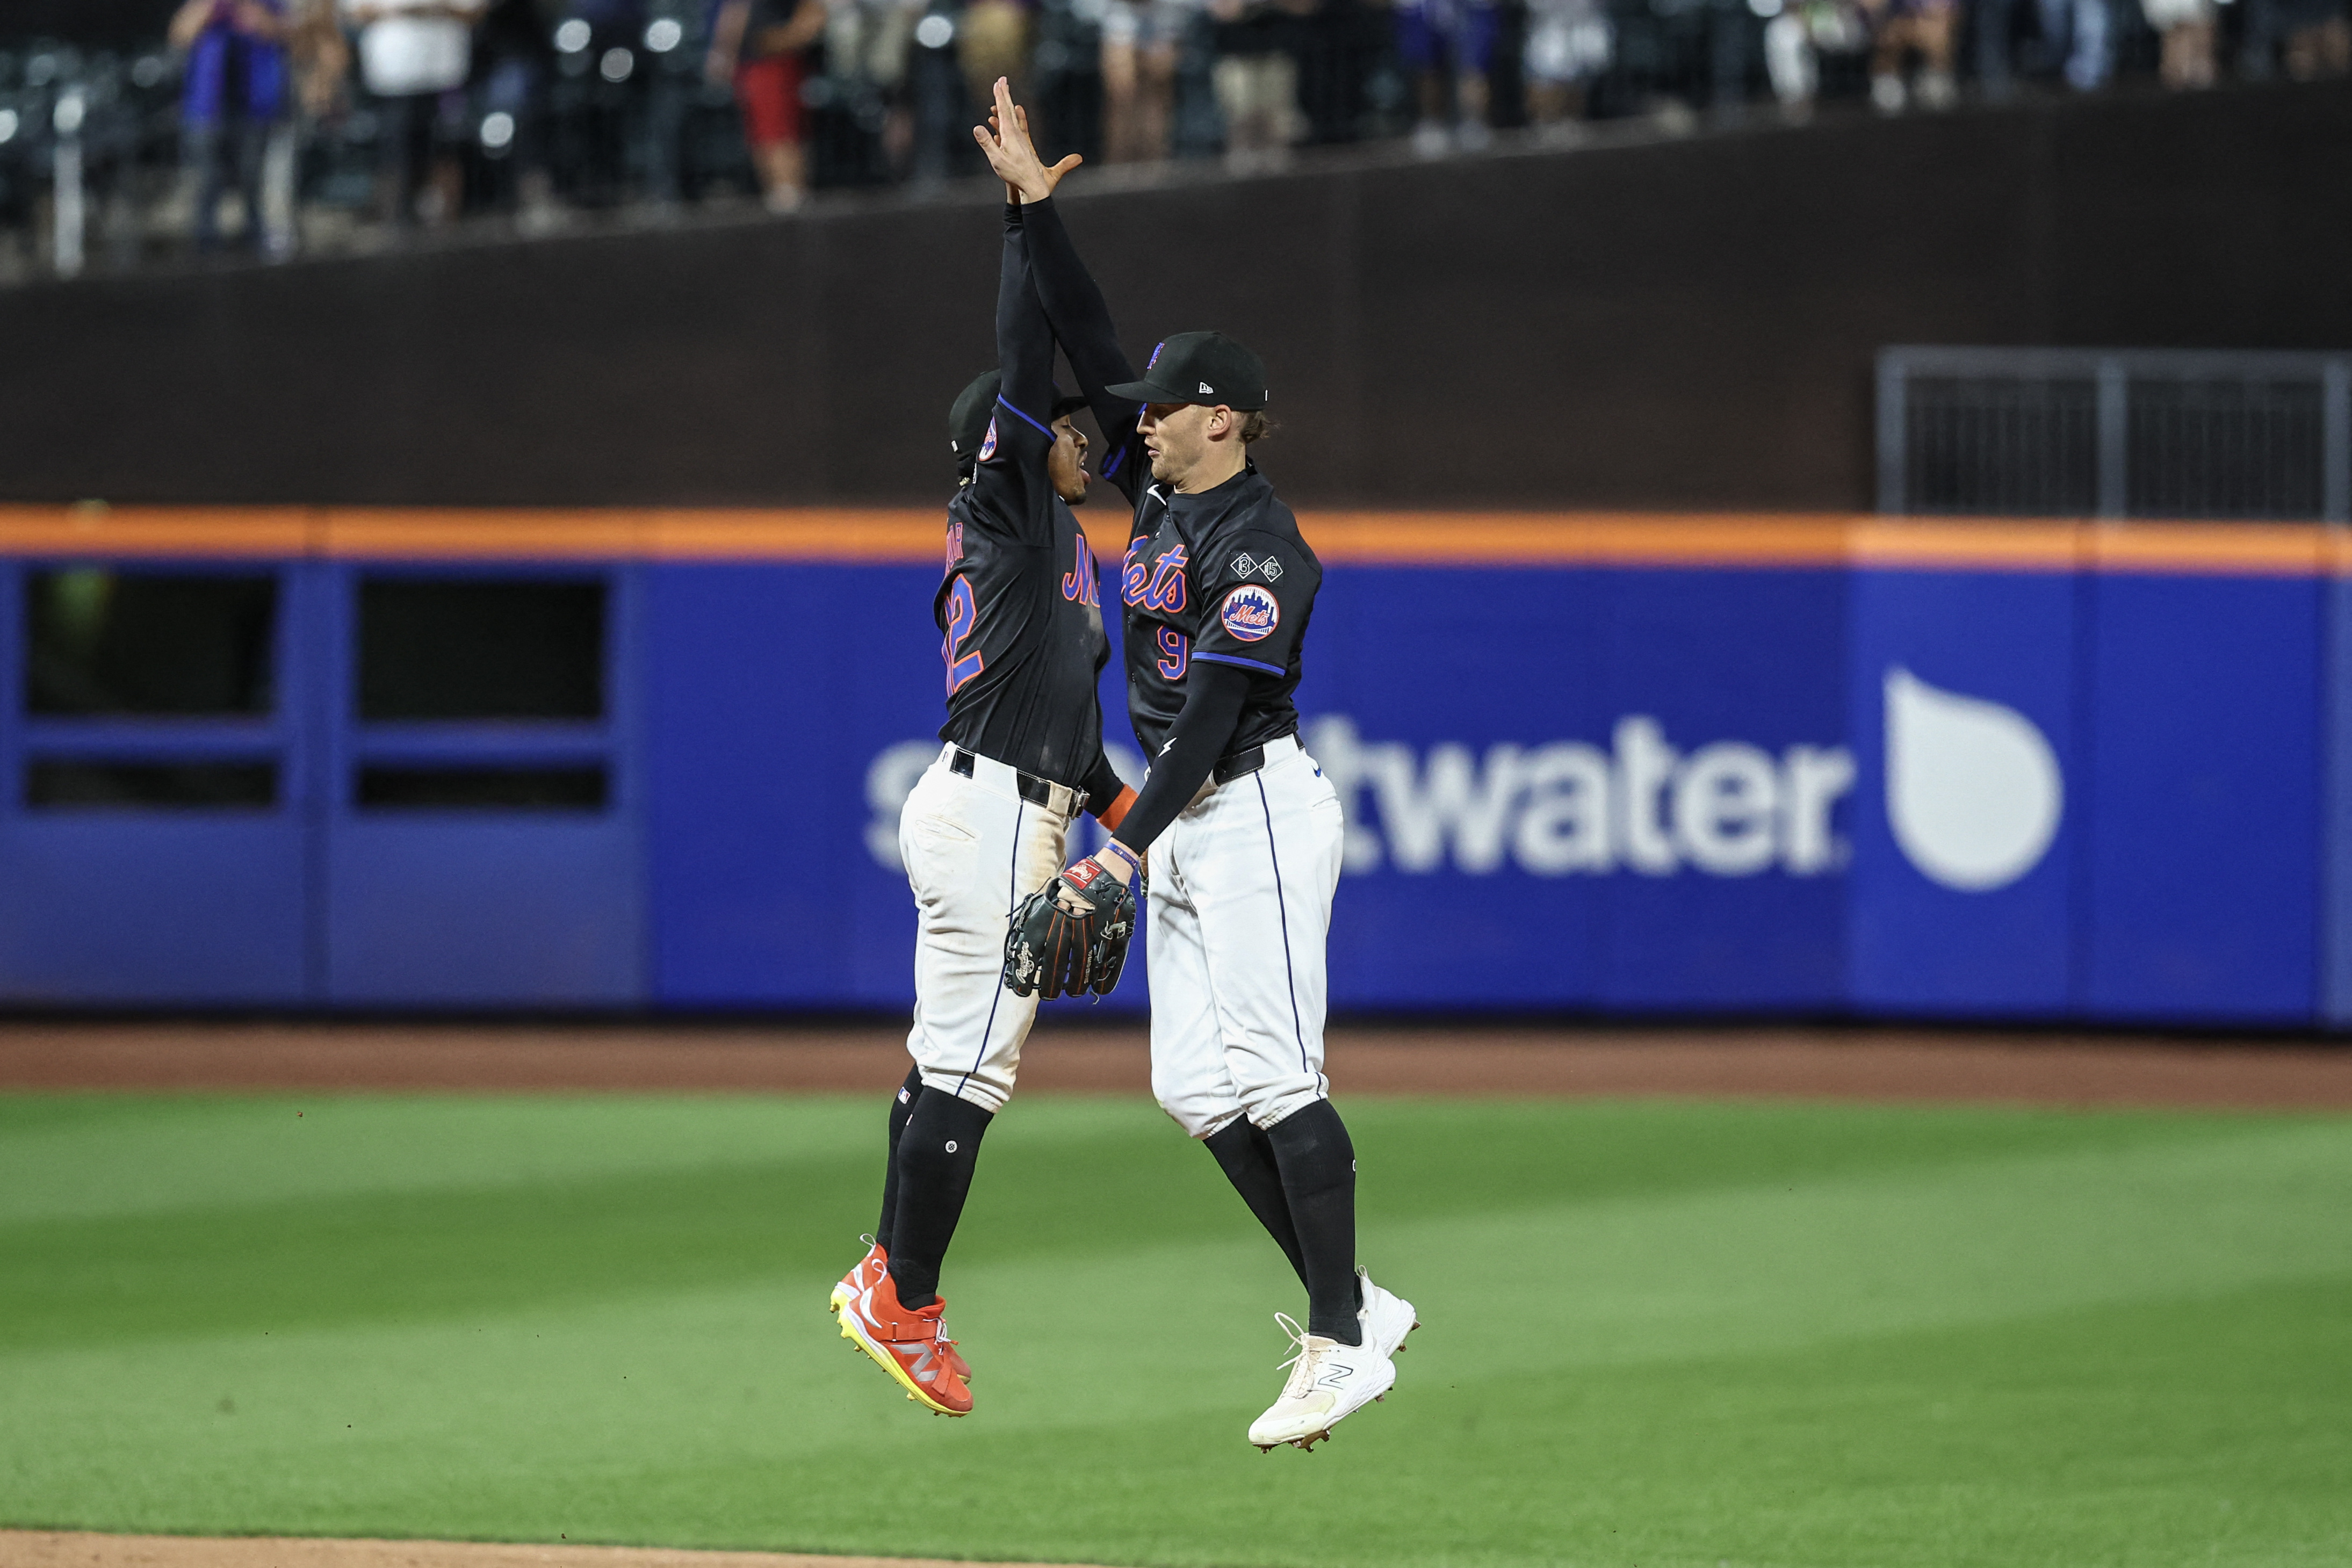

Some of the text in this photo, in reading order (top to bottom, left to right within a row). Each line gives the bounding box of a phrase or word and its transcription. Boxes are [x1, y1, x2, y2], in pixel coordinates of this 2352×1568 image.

[1238, 557, 1251, 575] 3
[1267, 561, 1278, 576] 15
[1229, 604, 1271, 626] Mets
[1157, 623, 1187, 681] 9
